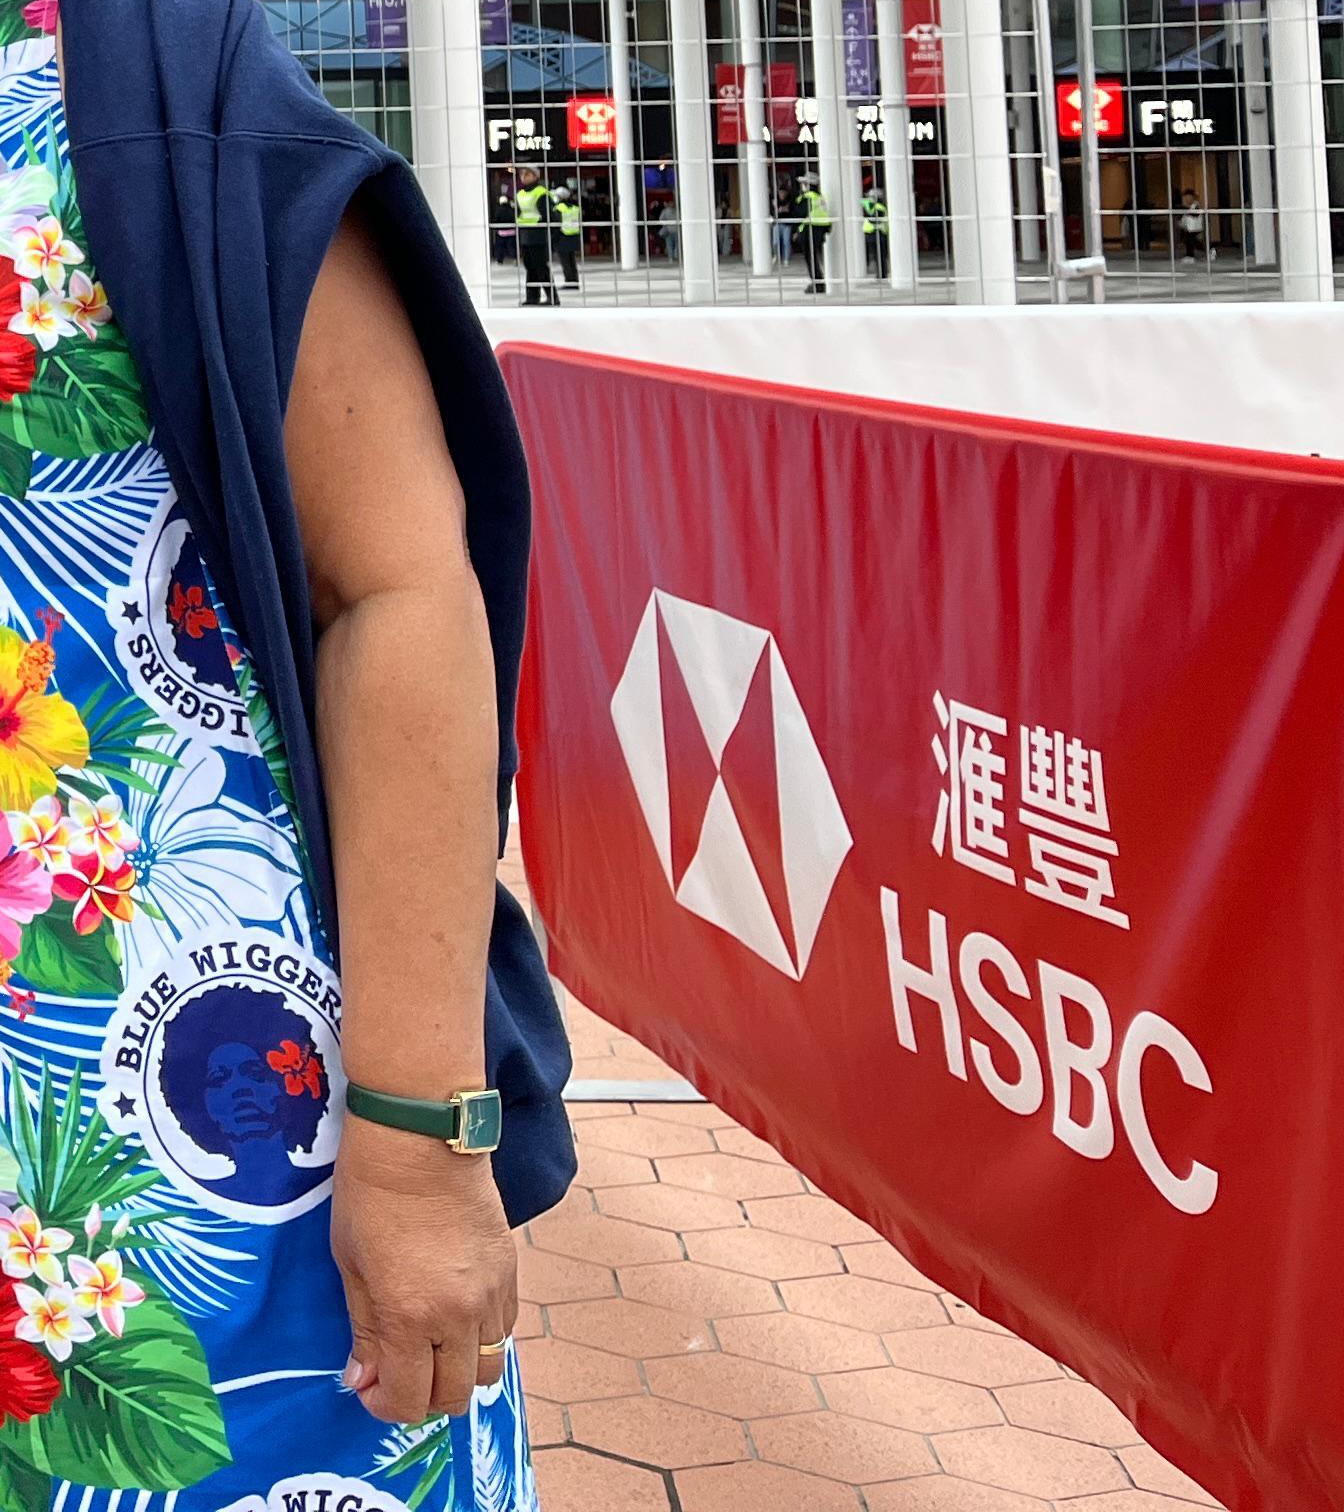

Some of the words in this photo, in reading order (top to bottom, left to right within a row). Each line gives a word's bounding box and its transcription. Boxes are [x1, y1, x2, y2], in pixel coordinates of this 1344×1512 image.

[128, 632, 250, 739] IGGERS
[115, 971, 178, 1074] BLUE
[189, 941, 343, 1030] WIGGER
[879, 884, 1220, 1217] HSBC
